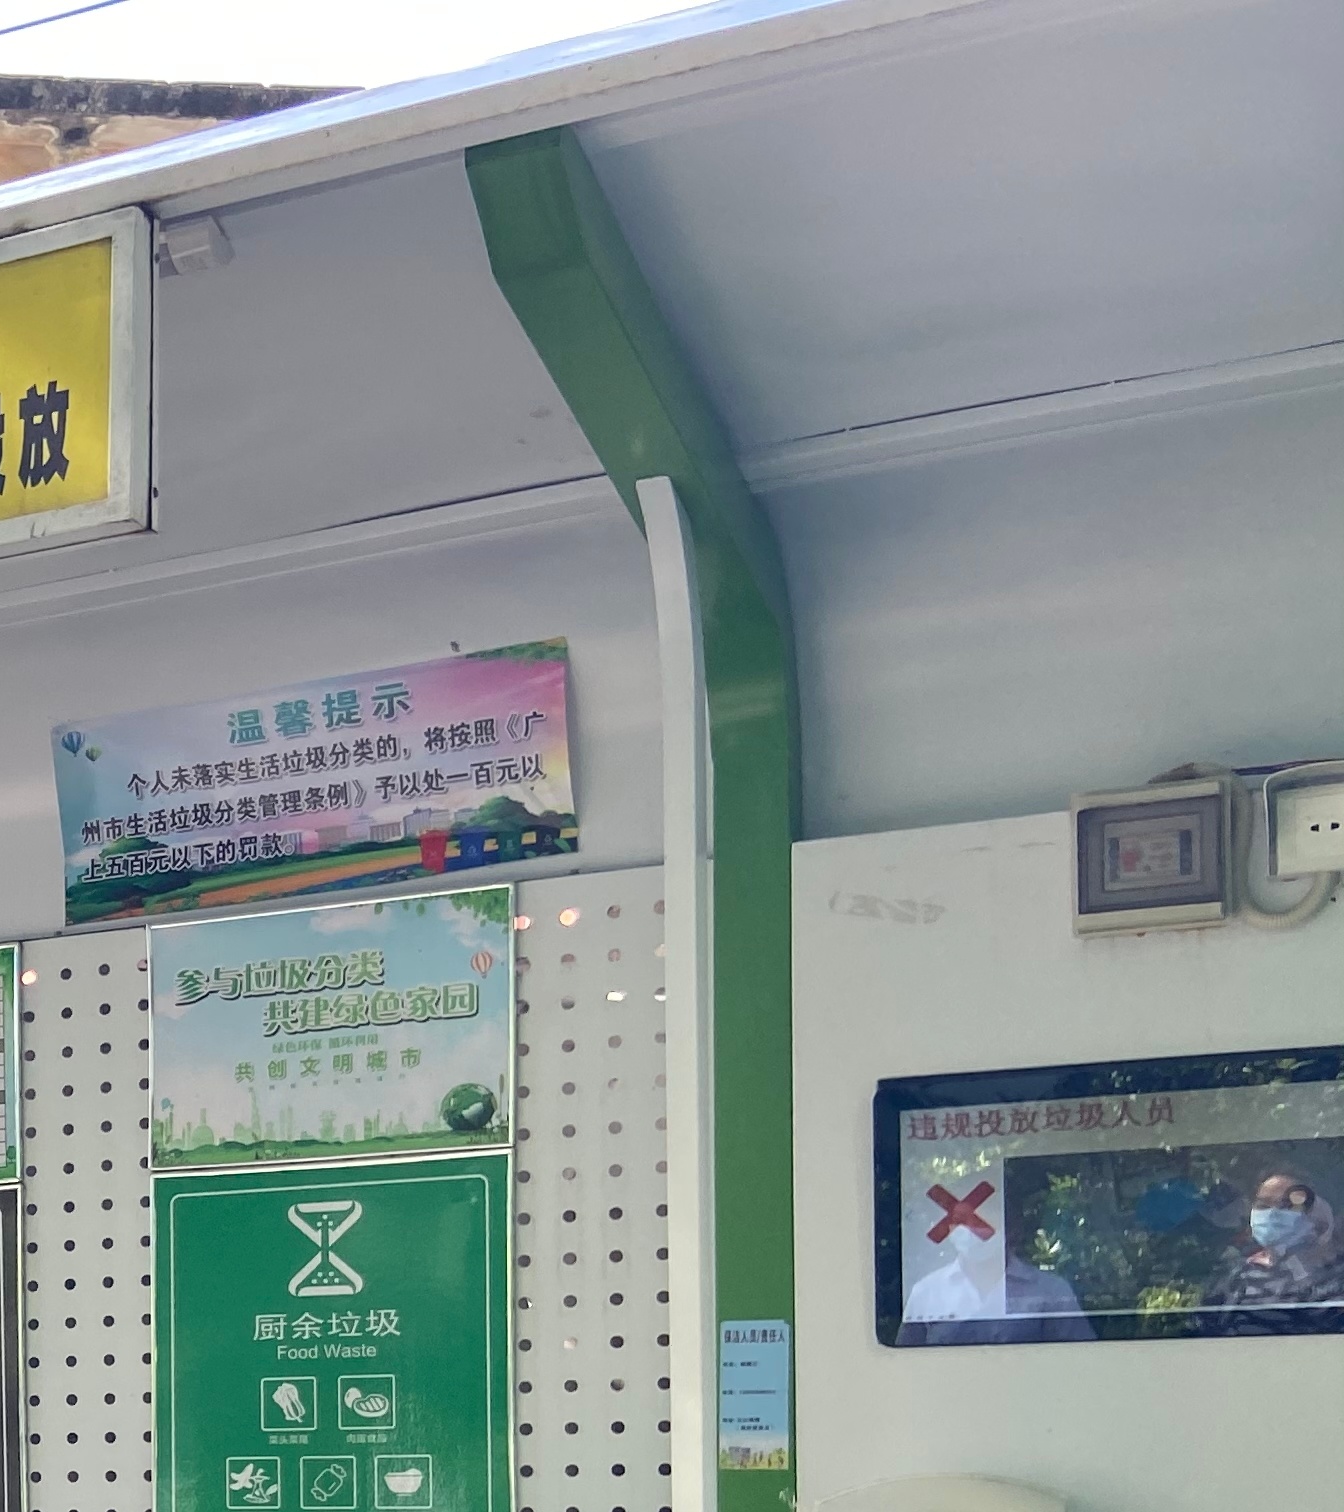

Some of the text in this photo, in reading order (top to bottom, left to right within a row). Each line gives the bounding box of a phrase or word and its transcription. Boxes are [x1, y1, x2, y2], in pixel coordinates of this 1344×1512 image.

[226, 681, 413, 748] 温馨提示
[174, 947, 386, 1005] 参与垃圾分类
[262, 981, 480, 1037] 共建绿色家园
[234, 1047, 422, 1083] 共创文明城市
[908, 1097, 1175, 1141] 违规投放垃圾人员
[253, 1309, 401, 1342] 厨余垃圾
[276, 1342, 378, 1360] Food Waste
